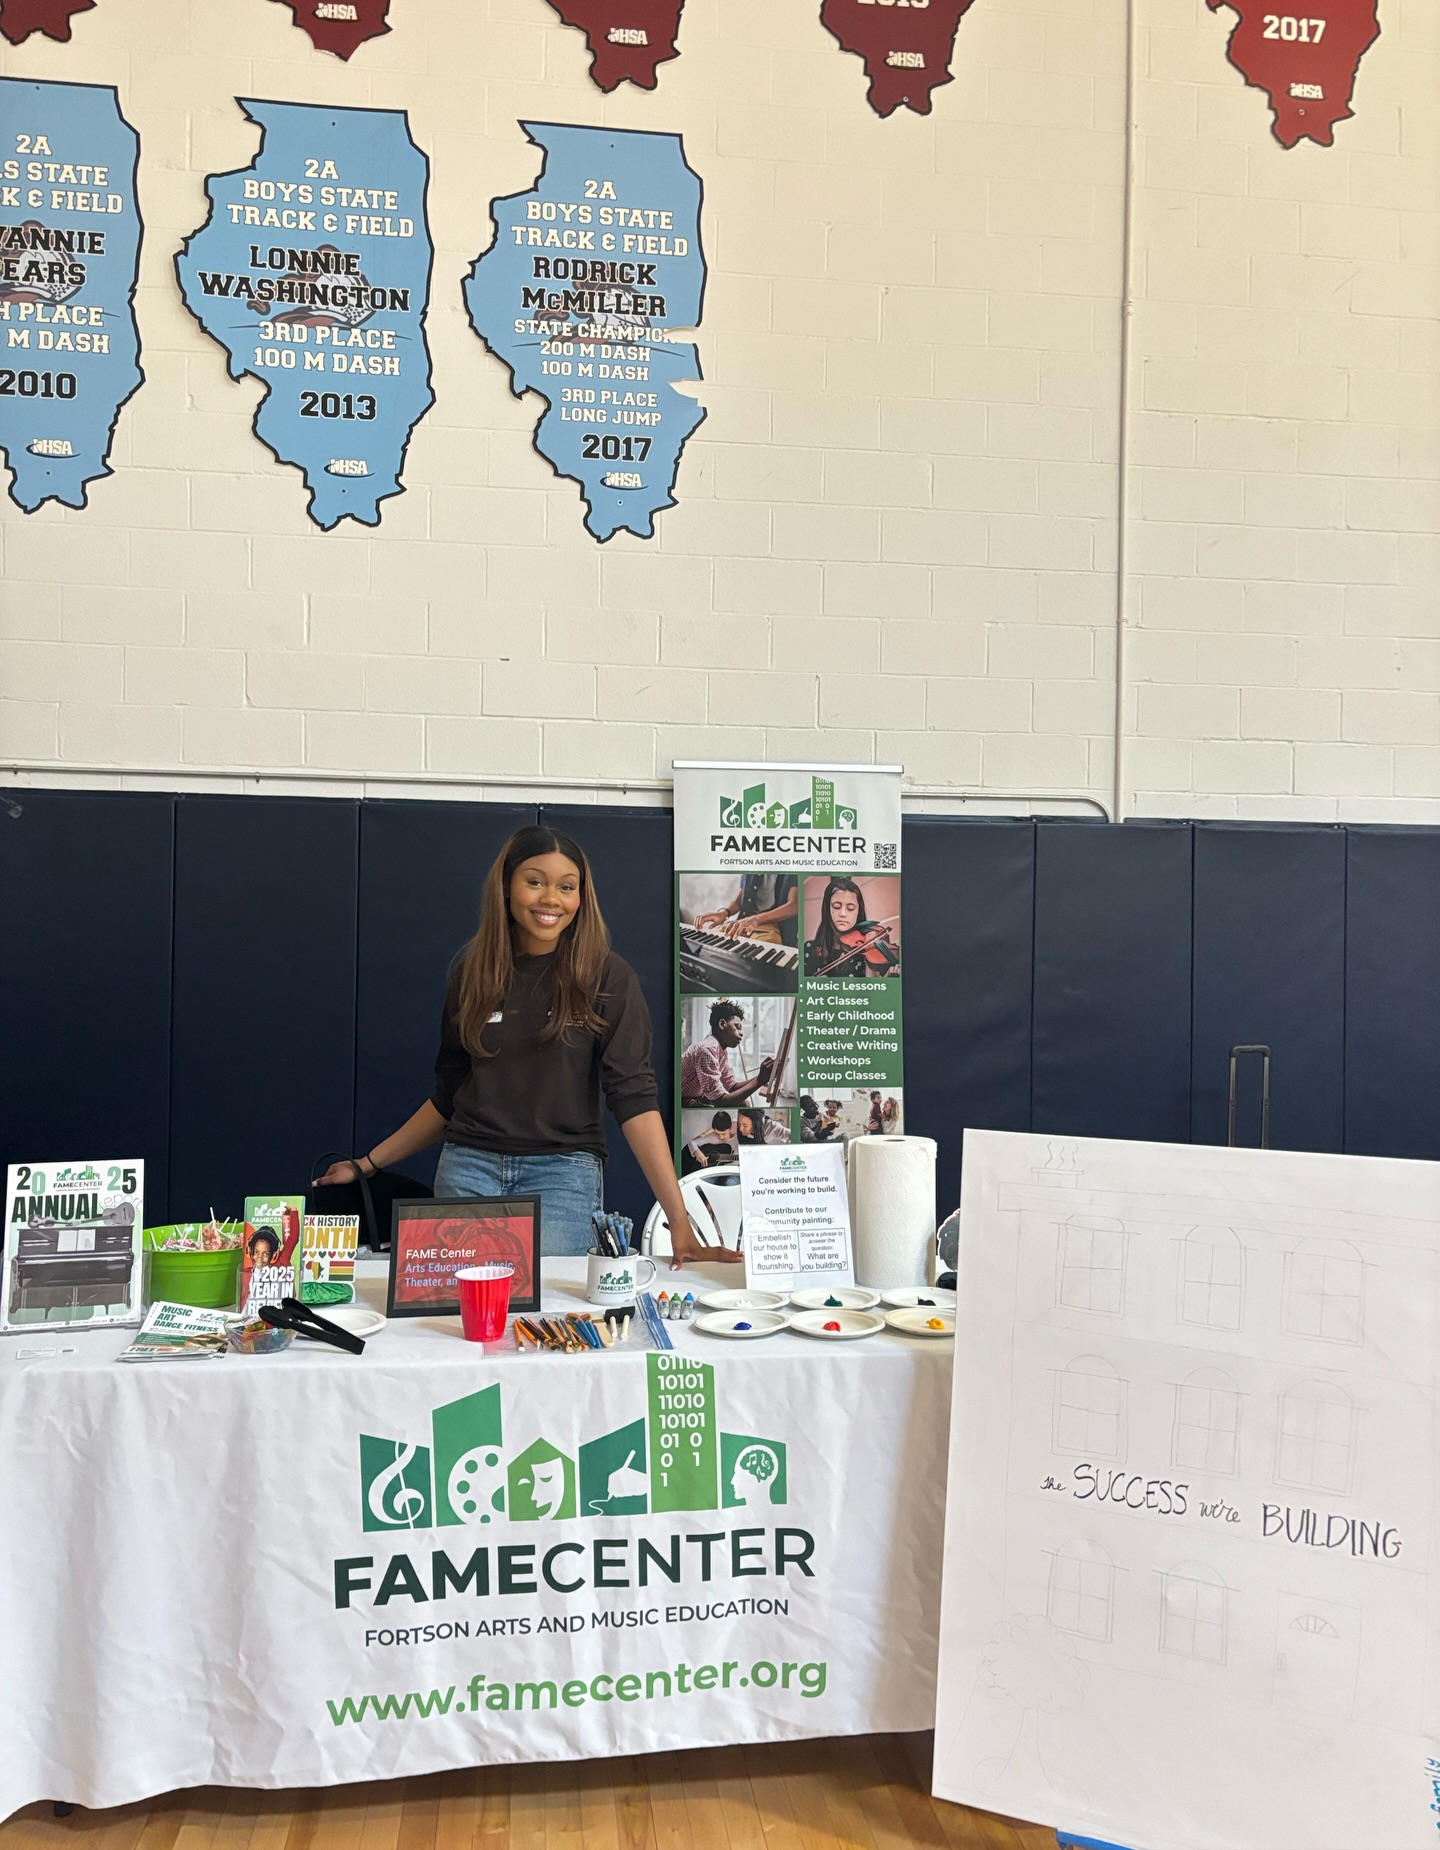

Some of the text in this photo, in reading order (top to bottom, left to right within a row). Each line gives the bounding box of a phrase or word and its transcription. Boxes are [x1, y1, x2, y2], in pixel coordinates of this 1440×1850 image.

[1263, 14, 1326, 44] 2017
[16, 134, 52, 156] 2A
[27, 162, 109, 187] STATE
[304, 158, 339, 180] 2A
[243, 179, 398, 210] BOYS STATE
[584, 179, 617, 200] 2A
[27, 189, 43, 208] &
[51, 190, 123, 214] FIELD
[227, 204, 414, 238] TRACK & FIELD
[527, 201, 673, 230] BOYS STATE
[511, 226, 688, 257] TRACK & FIELD
[249, 245, 361, 277] LONNIE
[533, 256, 657, 286] RODRICK
[197, 271, 410, 312] WASHINGTON
[19, 302, 104, 326] PLACE
[258, 321, 397, 350] 3RD PLACE
[514, 319, 572, 338] STATE
[8, 328, 110, 354] M DASH
[540, 341, 651, 362] 200 M DASH
[254, 347, 400, 376] 100 M DASH
[541, 360, 649, 381] 100 M DASH
[0, 369, 77, 400] 2010
[300, 391, 377, 421] 2013
[561, 388, 658, 407] 3RD PLACE
[561, 407, 662, 426] LONG JUMP
[581, 434, 653, 462] 2017
[710, 835, 867, 853] FAMECENTER
[806, 981, 887, 991] Music Lessons
[806, 996, 869, 1006] Art Classes
[807, 1010, 895, 1022] Early Childhood
[807, 1025, 896, 1036] Theater / Drama
[807, 1041, 898, 1052] Creative Writing
[807, 1056, 871, 1067] Workshops
[807, 1071, 887, 1082] Group Classes
[53, 1180, 103, 1189] FAMECENTER
[807, 1175, 829, 1183] future
[751, 1188, 775, 1197] you're
[777, 1187, 806, 1195] working
[817, 1185, 838, 1193] build.
[11, 1193, 103, 1223] ANNUAL
[764, 1206, 804, 1214] Contribute
[317, 1216, 357, 1227] HISTORY
[802, 1217, 835, 1226] painting:
[757, 1234, 792, 1242] Embellish
[406, 1248, 476, 1259] FAME Center
[807, 1252, 826, 1260] What
[261, 1265, 295, 1282] 2025
[405, 1263, 425, 1273] Arts
[815, 1260, 847, 1270] building?
[249, 1282, 294, 1298] YEAR IN
[405, 1276, 443, 1288] Theater,
[156, 1312, 176, 1321] ART
[161, 1305, 193, 1317] MUSIC
[153, 1320, 183, 1329] DANCE
[184, 1323, 219, 1332] FITNESS
[657, 1373, 704, 1390] 10101
[658, 1393, 706, 1410] 11010
[659, 1412, 706, 1430] 10101
[660, 1433, 679, 1449] 01
[1040, 1475, 1066, 1492] the
[1073, 1463, 1189, 1515] SUCCESS
[1261, 1503, 1402, 1558] BUILDING
[333, 1528, 816, 1610] FAMECENTER
[364, 1597, 789, 1648] FORTSON ARTS AND MUSIC EDUCATION
[326, 1659, 828, 1727] www.famecenter.org
